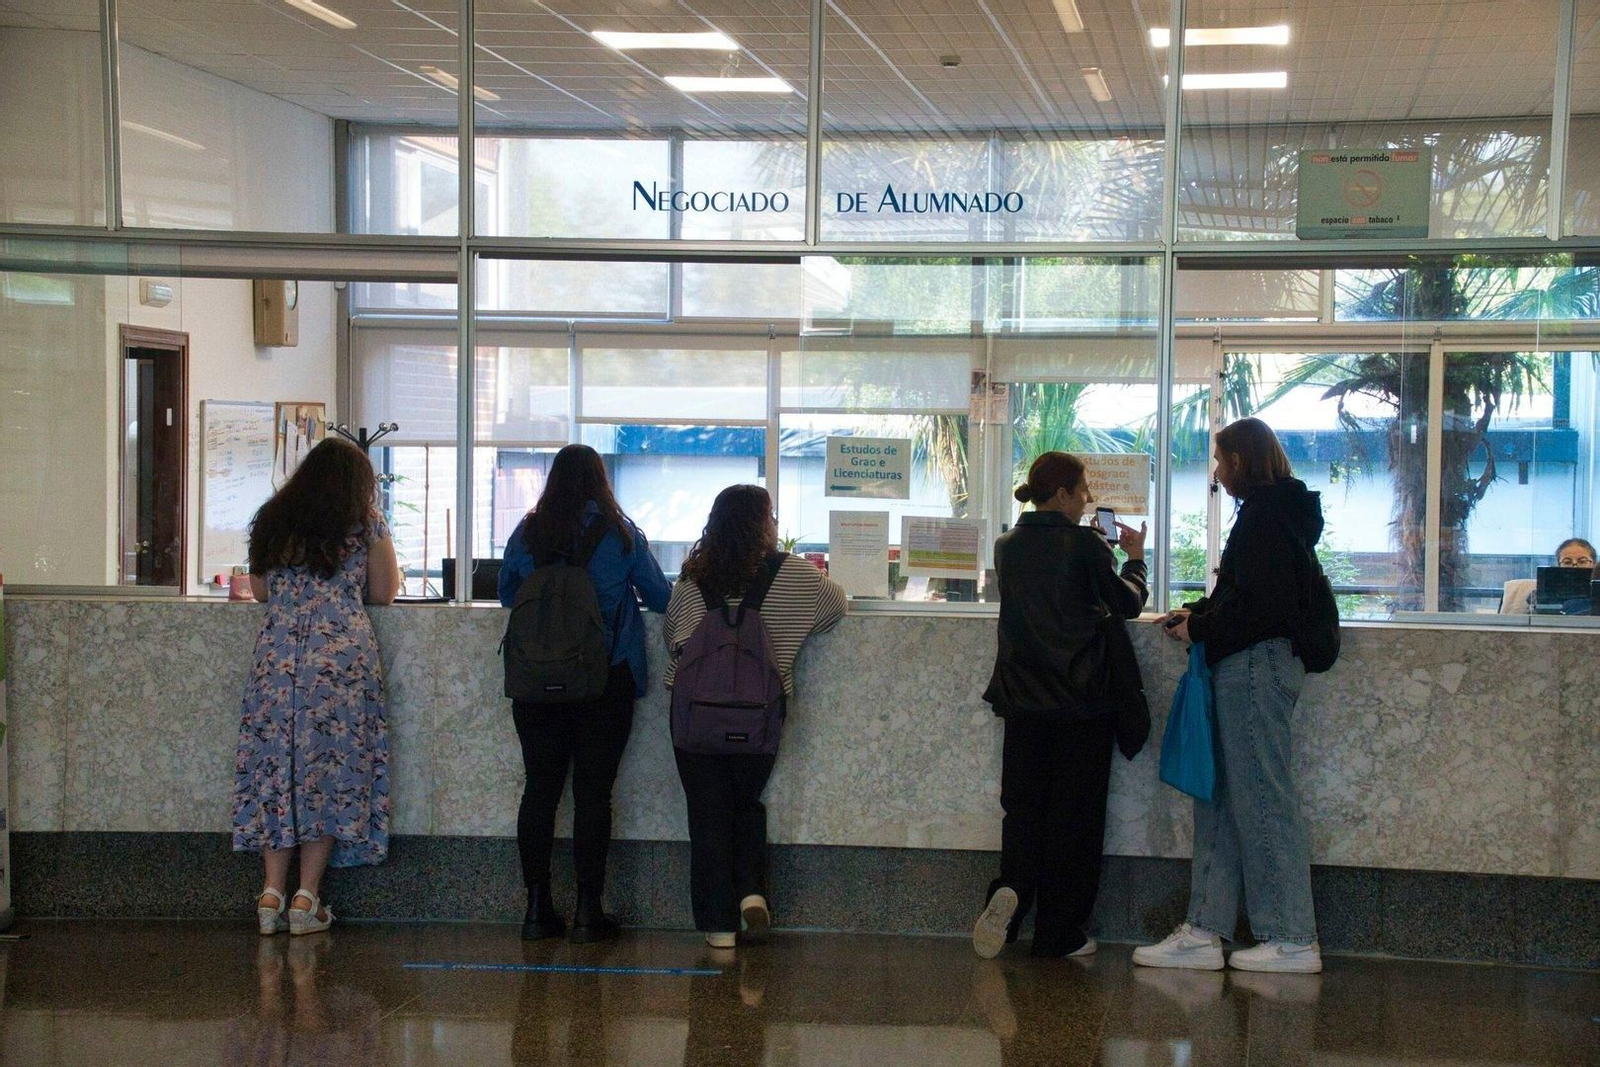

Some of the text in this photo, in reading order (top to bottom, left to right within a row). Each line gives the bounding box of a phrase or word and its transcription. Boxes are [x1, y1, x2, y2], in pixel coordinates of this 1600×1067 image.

[1331, 154, 1347, 163] está
[1350, 153, 1390, 165] permitido
[1320, 216, 1349, 225] espacio
[1368, 215, 1394, 224] tabaco
[840, 444, 897, 456] Estudos de
[851, 456, 886, 467] Grao e
[1082, 456, 1136, 467] studos de
[833, 468, 903, 480] Licenciaturas
[1123, 482, 1130, 491] e
